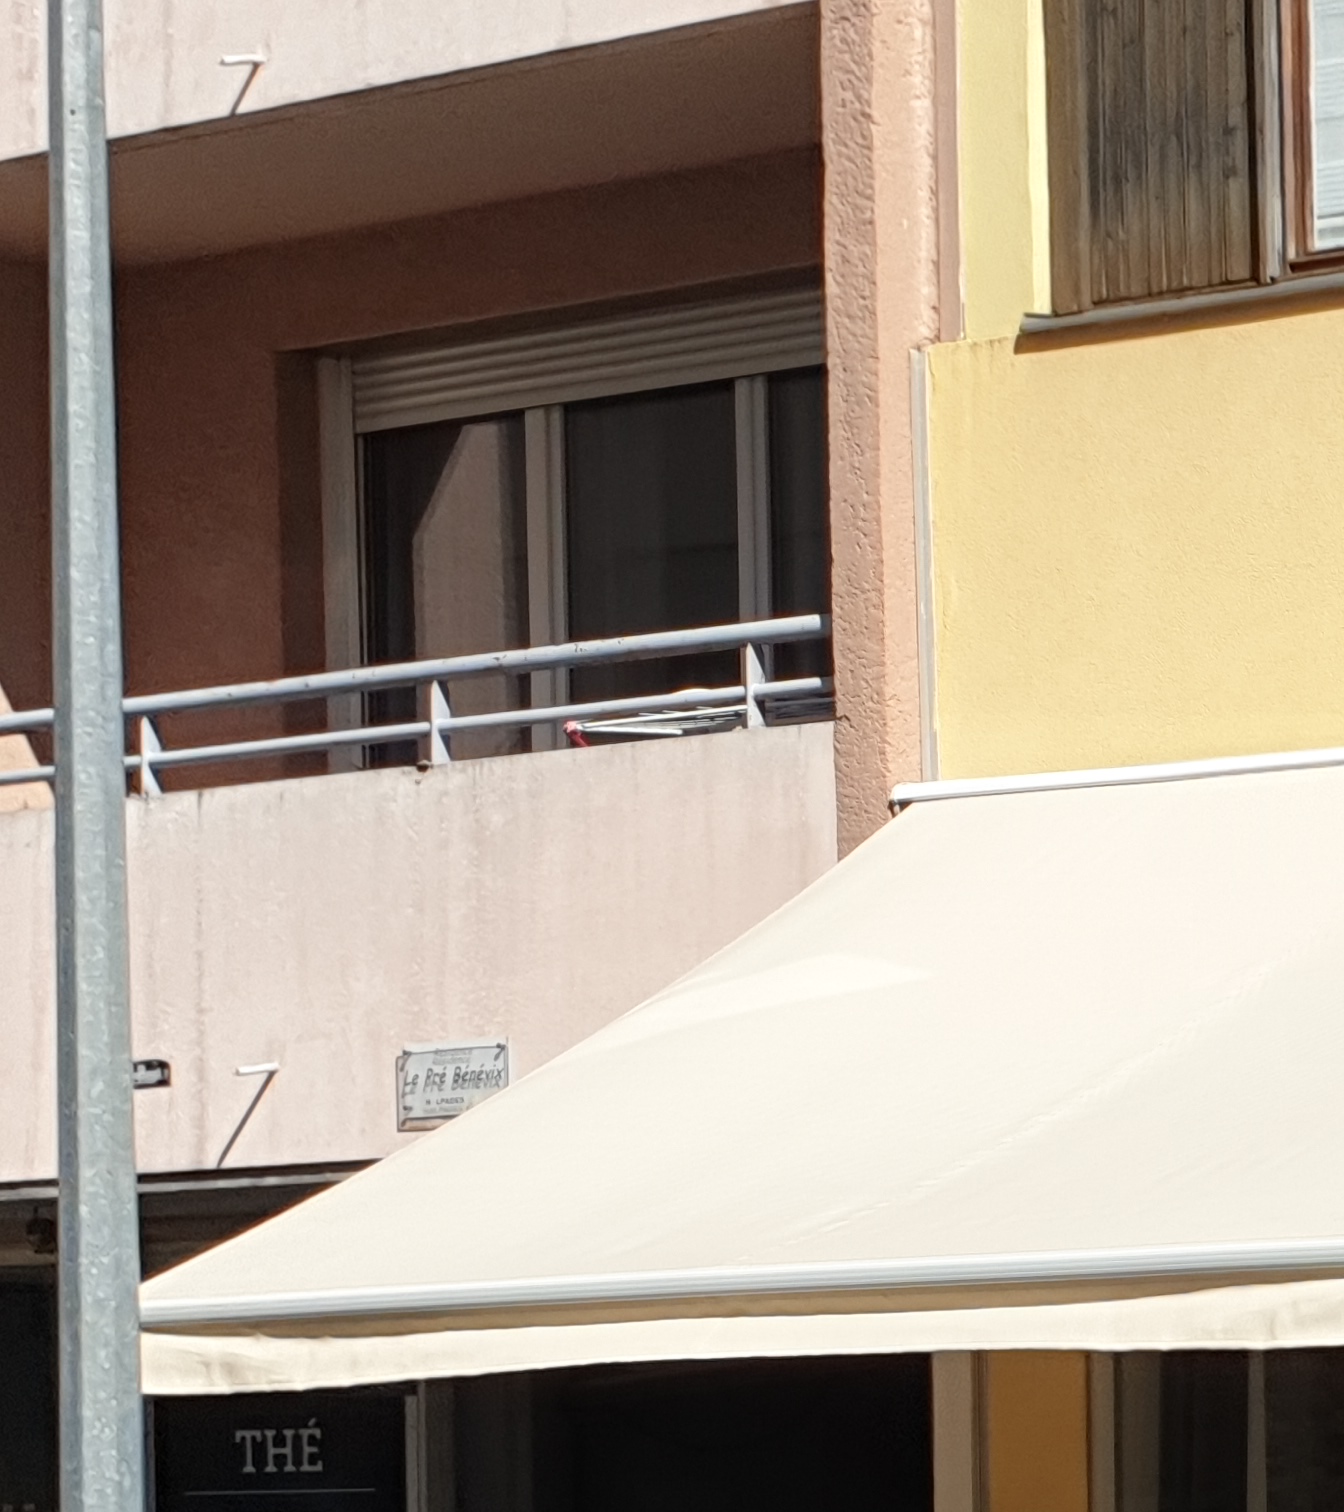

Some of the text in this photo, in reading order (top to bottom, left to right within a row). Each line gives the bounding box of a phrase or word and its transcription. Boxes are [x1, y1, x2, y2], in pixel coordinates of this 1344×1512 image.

[403, 1063, 504, 1088] Le Pré Bénévix
[235, 1418, 324, 1475] THÉ
